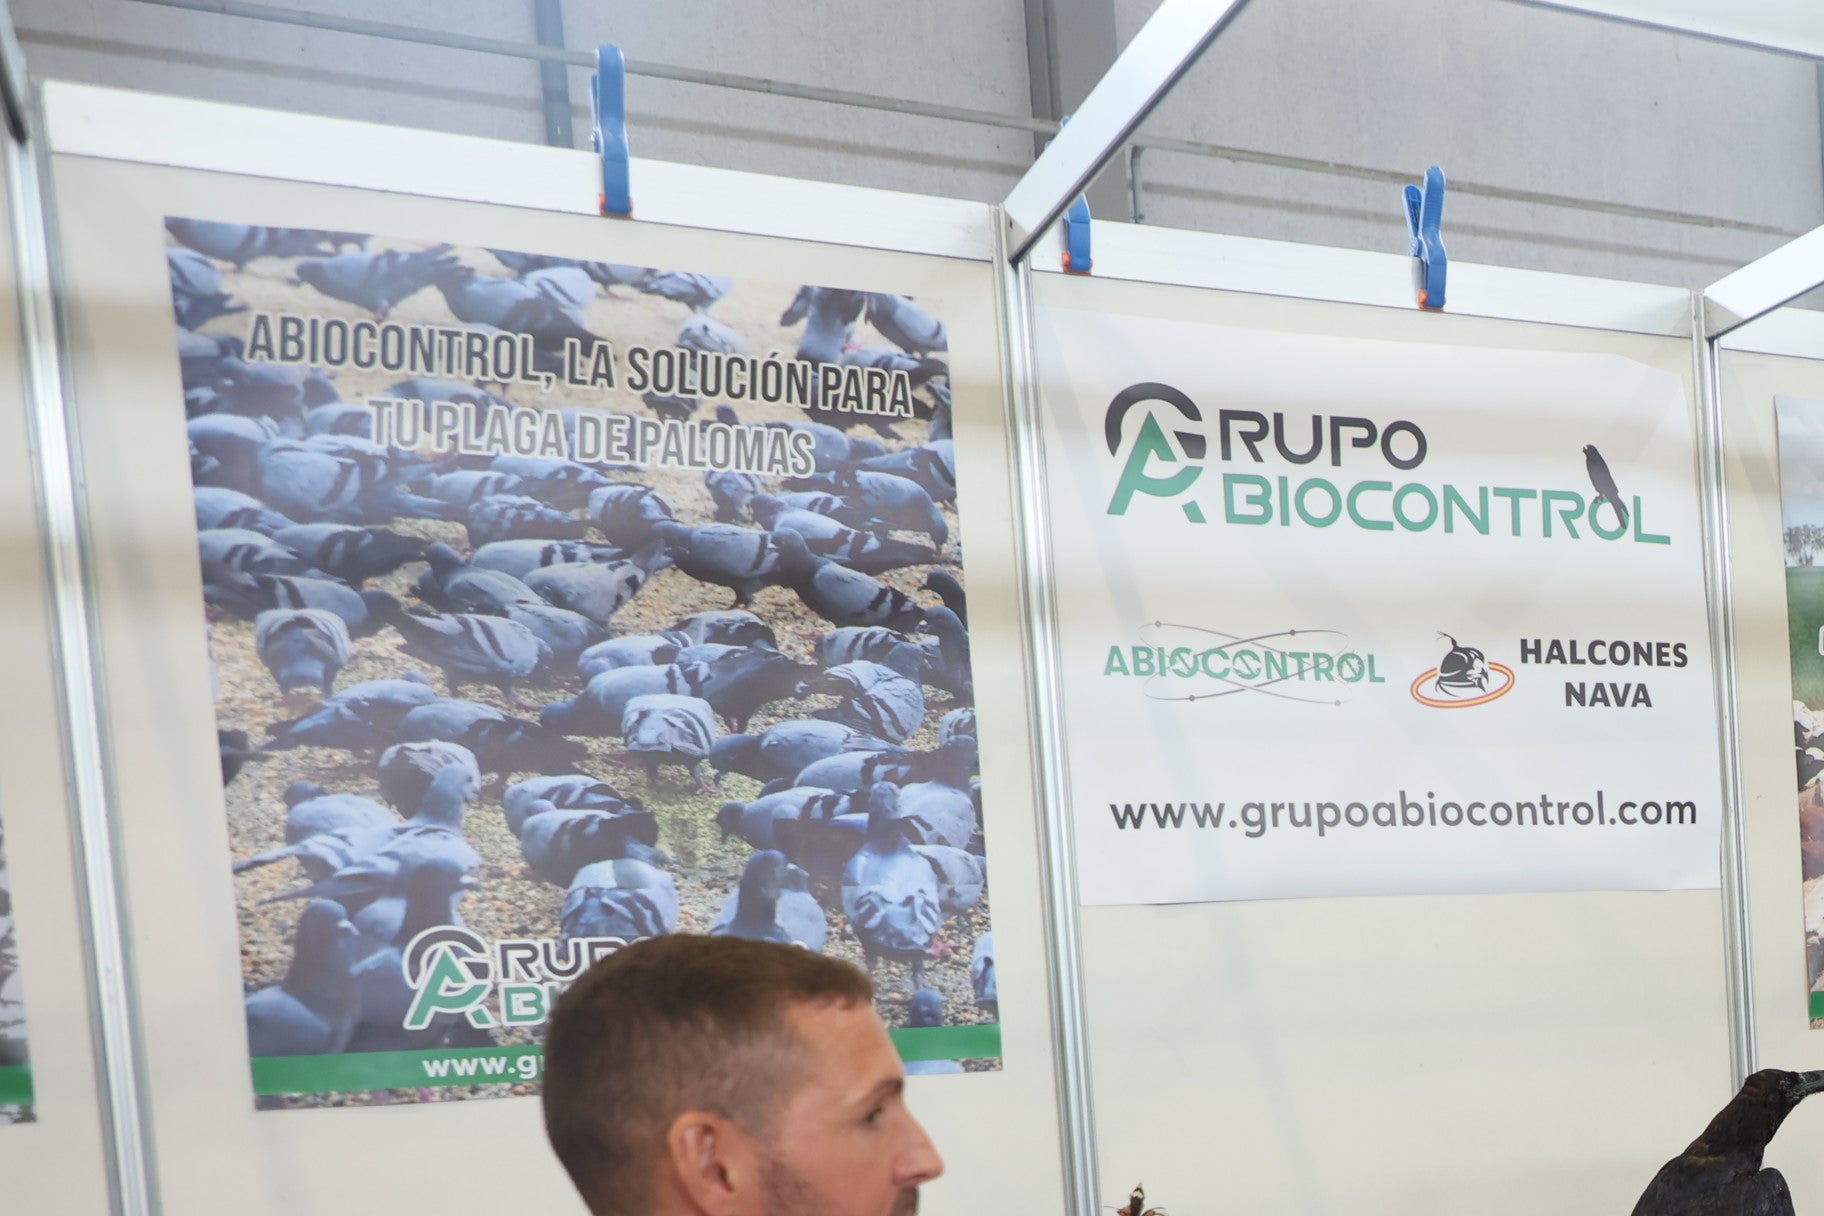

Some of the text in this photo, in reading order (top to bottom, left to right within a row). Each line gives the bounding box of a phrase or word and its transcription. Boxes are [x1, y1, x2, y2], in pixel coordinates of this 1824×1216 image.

[248, 313, 913, 416] ABIOCONTROL, LA SOLUCIÓN PARA
[369, 400, 815, 477] TU PLAGA DE PALOMAS
[1104, 381, 1428, 470] GRUPO
[1106, 410, 1672, 545] ABIOCONTROL
[1103, 645, 1387, 685] ABIOCONTROL
[1519, 638, 1689, 669] HALCONES
[1564, 681, 1653, 709] NAVA
[1108, 790, 1698, 839] www.grupoabiocontrol.com
